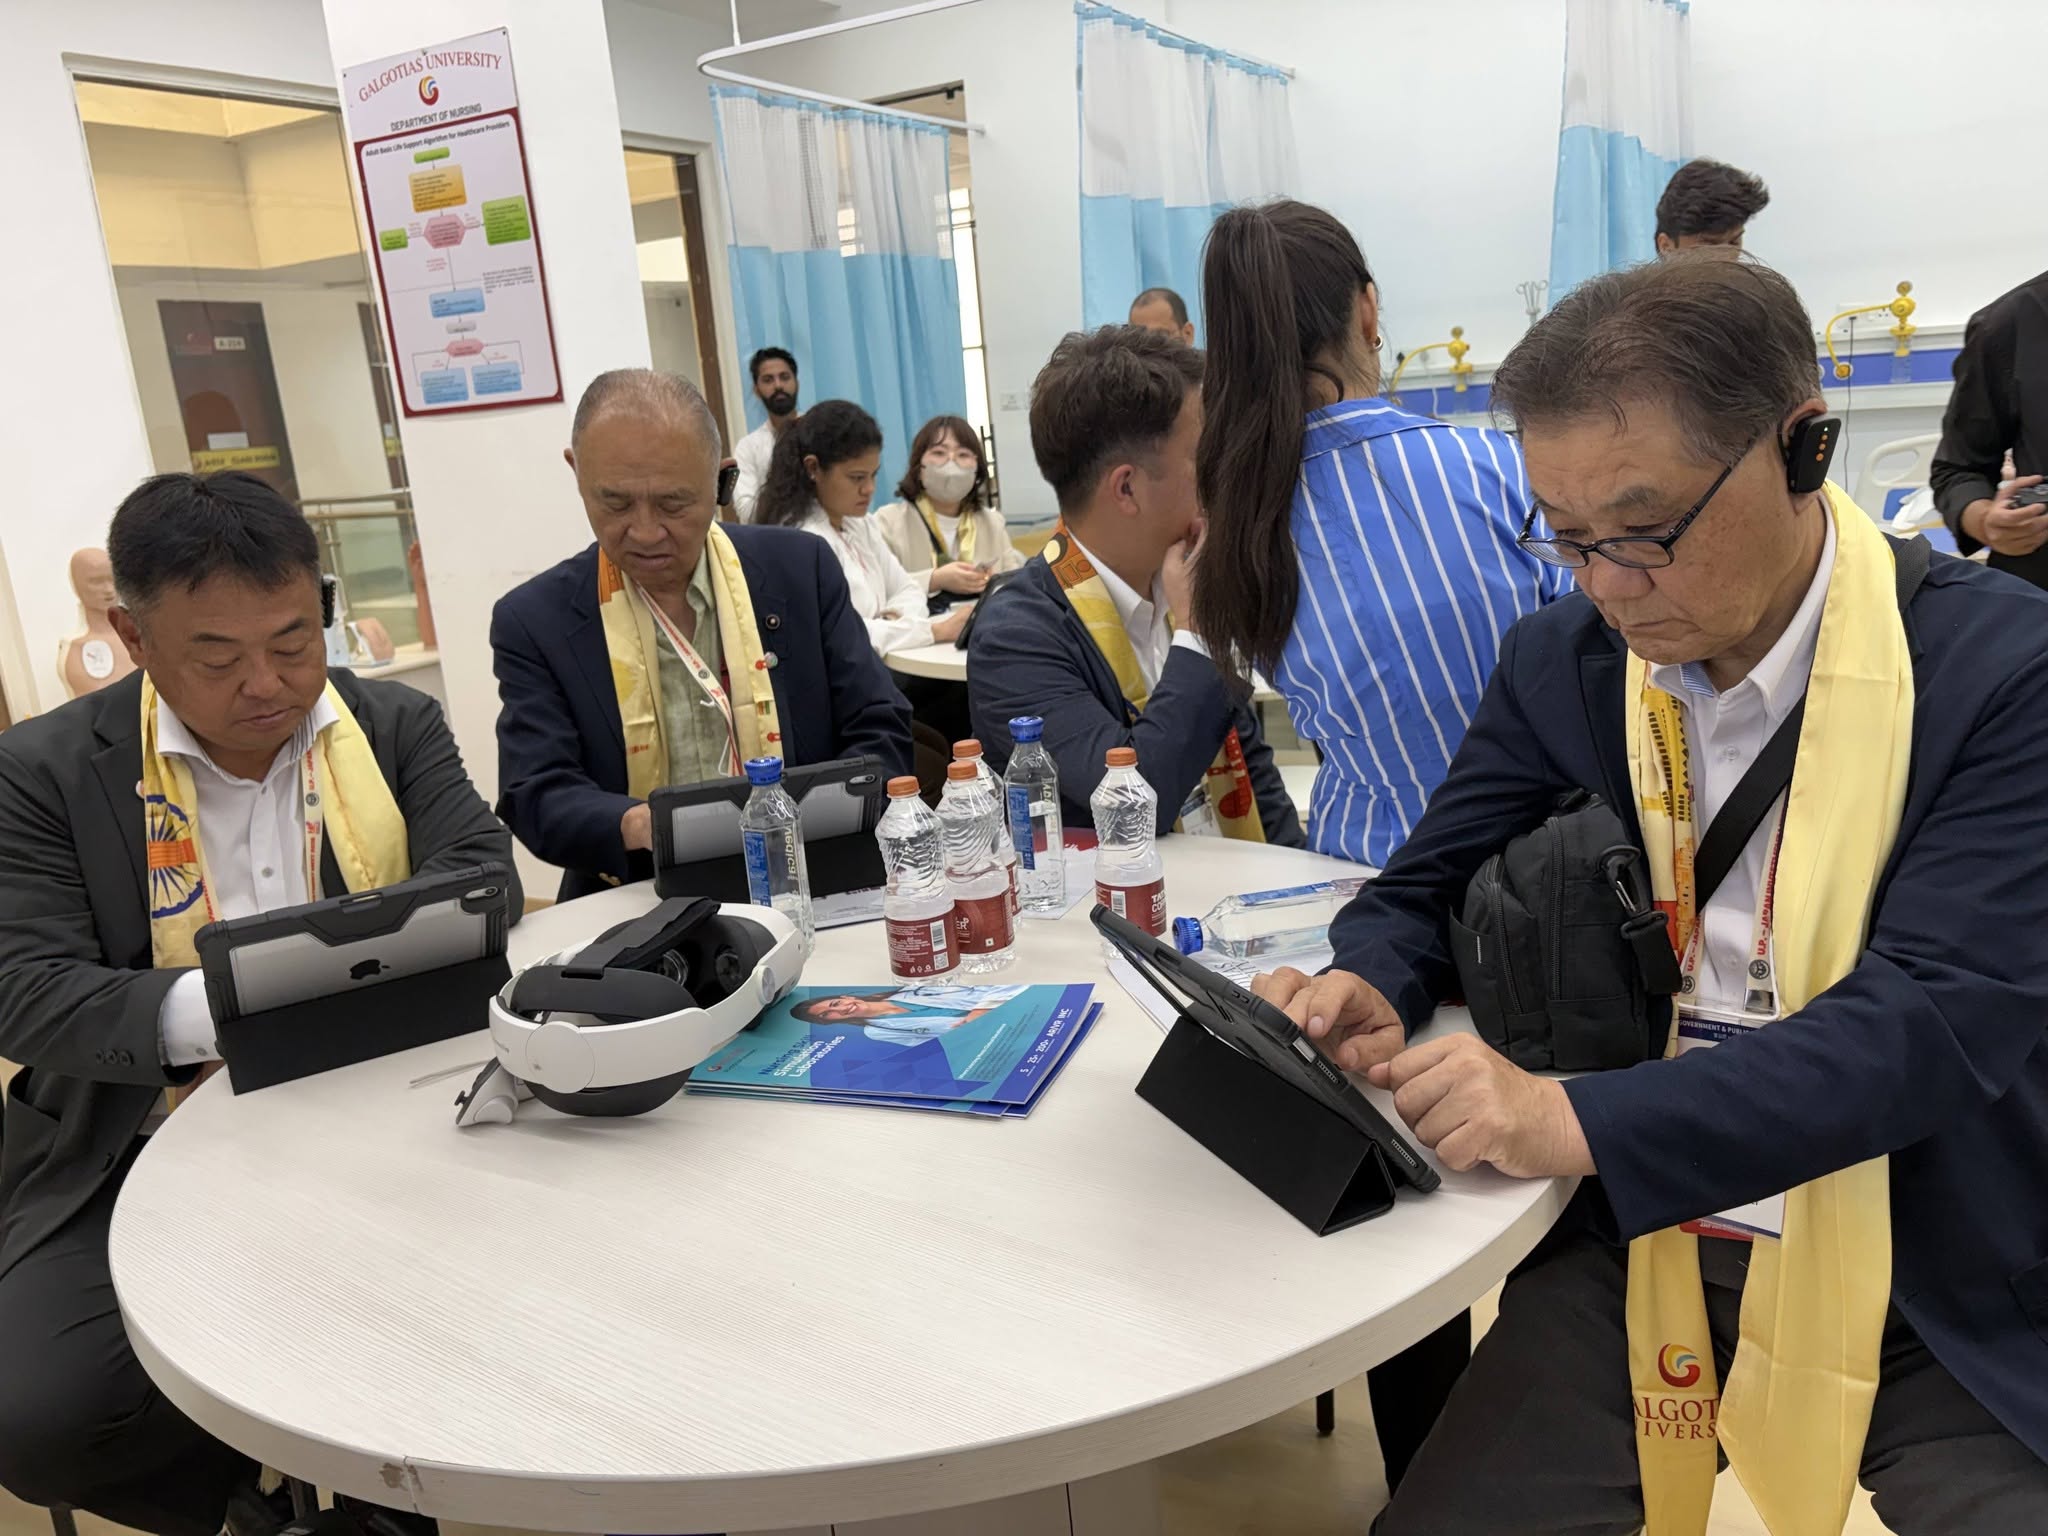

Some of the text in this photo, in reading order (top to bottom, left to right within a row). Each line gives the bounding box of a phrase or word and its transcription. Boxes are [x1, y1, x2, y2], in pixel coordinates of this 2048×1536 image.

[358, 51, 502, 101] GALGOTIAS UNIVERSITY
[390, 103, 482, 132] DEPARTMENT OF NURSING
[366, 121, 510, 157] Adult Basic Life Support Algorithm for Healthcare Providers
[1757, 935, 1768, 956] U.P.
[774, 1040, 824, 1076] Simulation
[788, 1035, 845, 1077] Laboratories
[1636, 1420, 1716, 1440] IVERS
